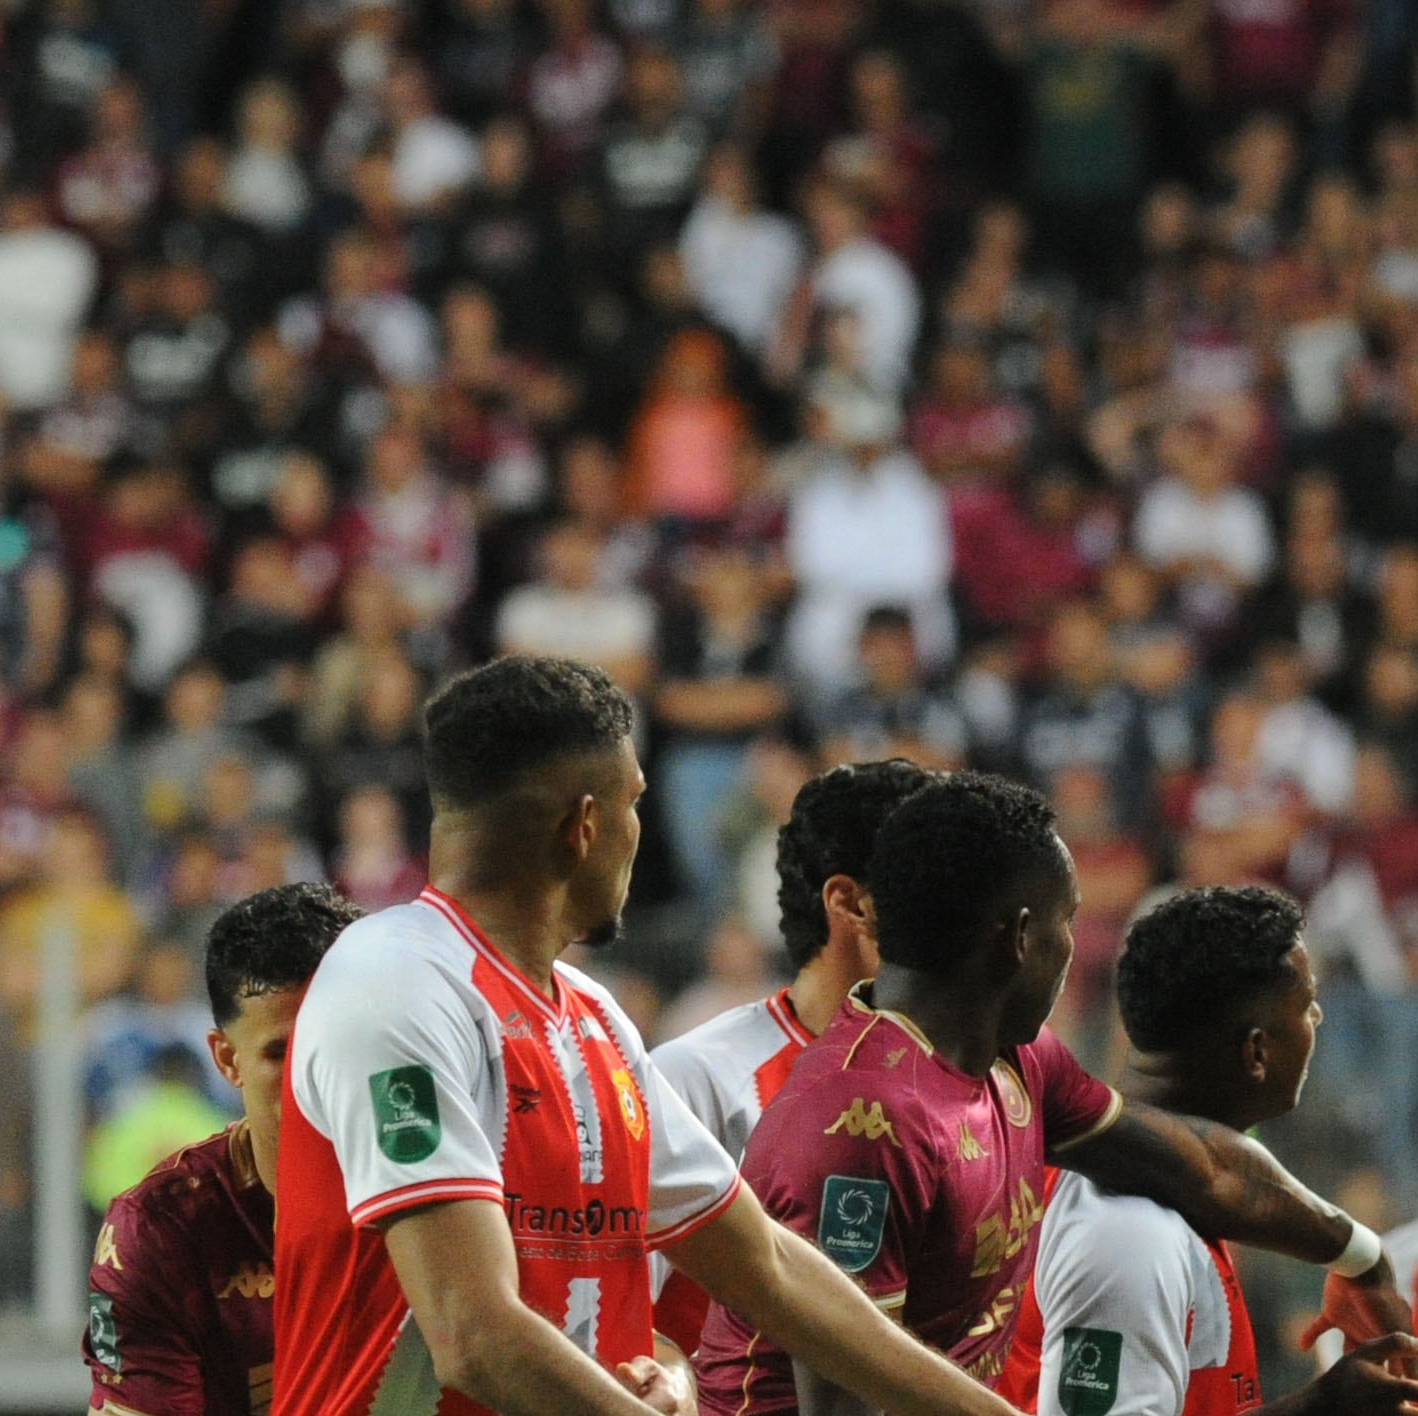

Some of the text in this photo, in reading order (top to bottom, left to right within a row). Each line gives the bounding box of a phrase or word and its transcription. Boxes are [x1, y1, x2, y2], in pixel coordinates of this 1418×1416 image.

[842, 1229, 861, 1242] Liga
[826, 1236, 874, 1249] Promerica
[1077, 1369, 1096, 1381] Liga
[1065, 1376, 1110, 1391] Promerica
